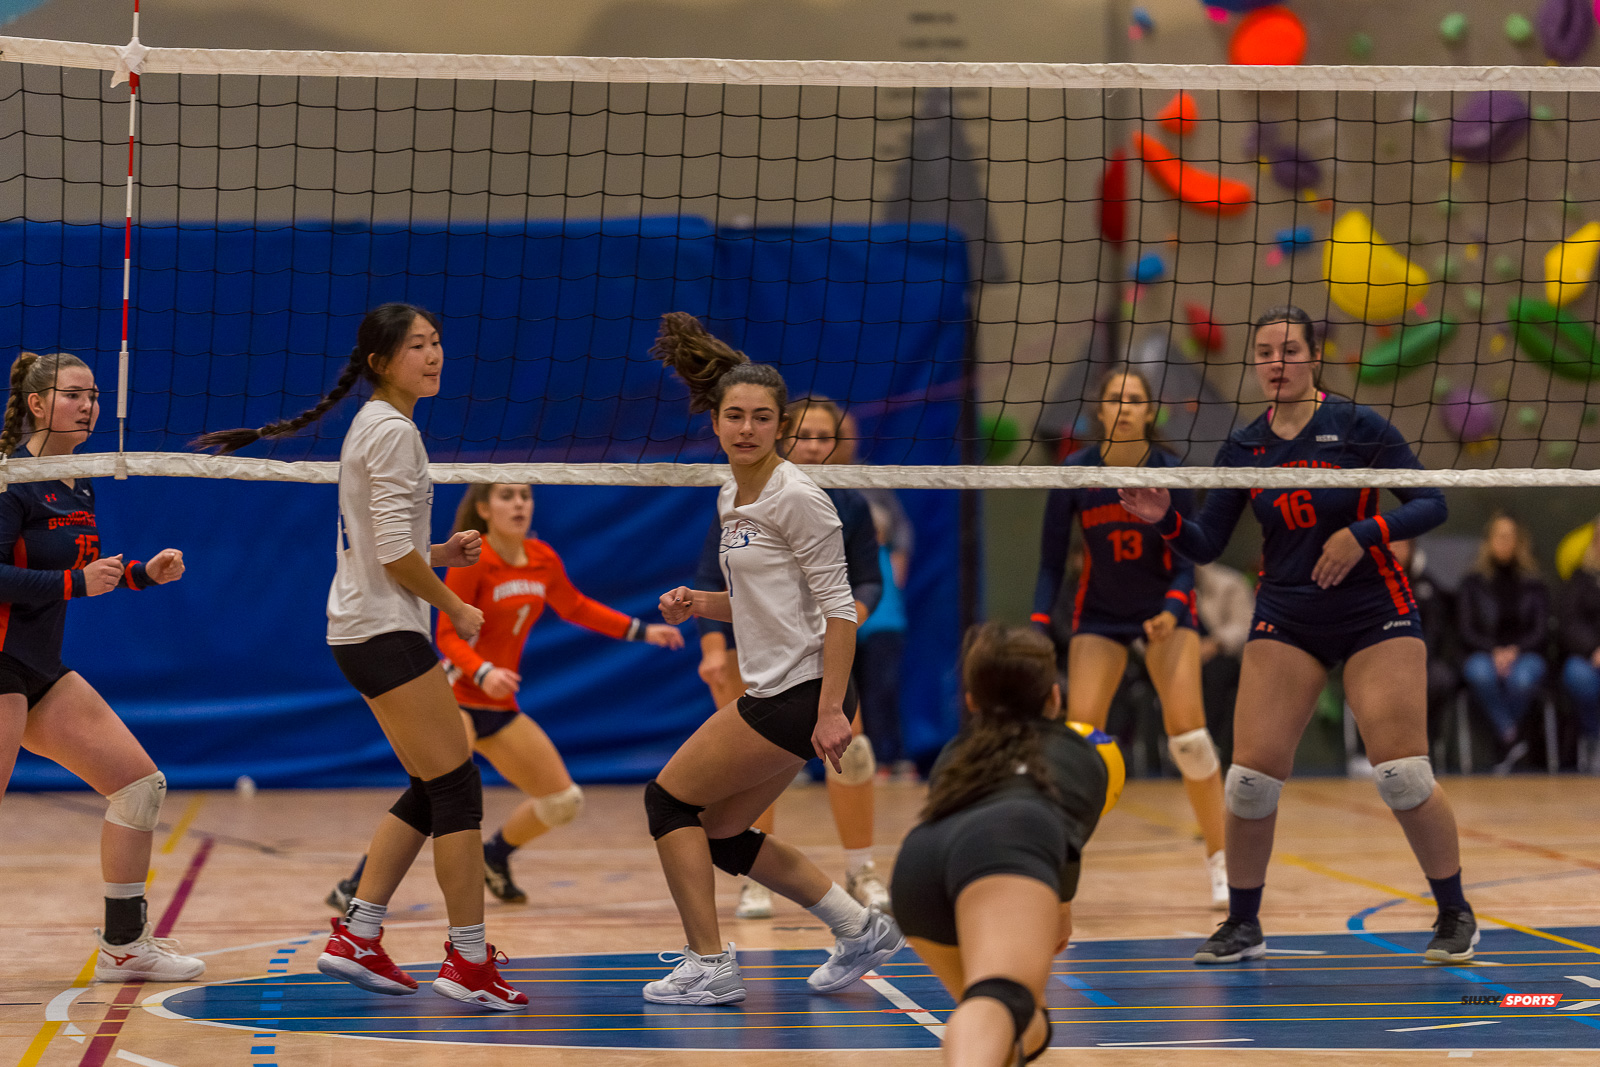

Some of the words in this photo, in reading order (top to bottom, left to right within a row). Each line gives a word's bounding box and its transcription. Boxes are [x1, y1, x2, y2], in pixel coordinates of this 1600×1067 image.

[1272, 489, 1317, 530] 16
[71, 534, 99, 570] 15
[1107, 529, 1143, 562] 13
[512, 603, 531, 636] 1
